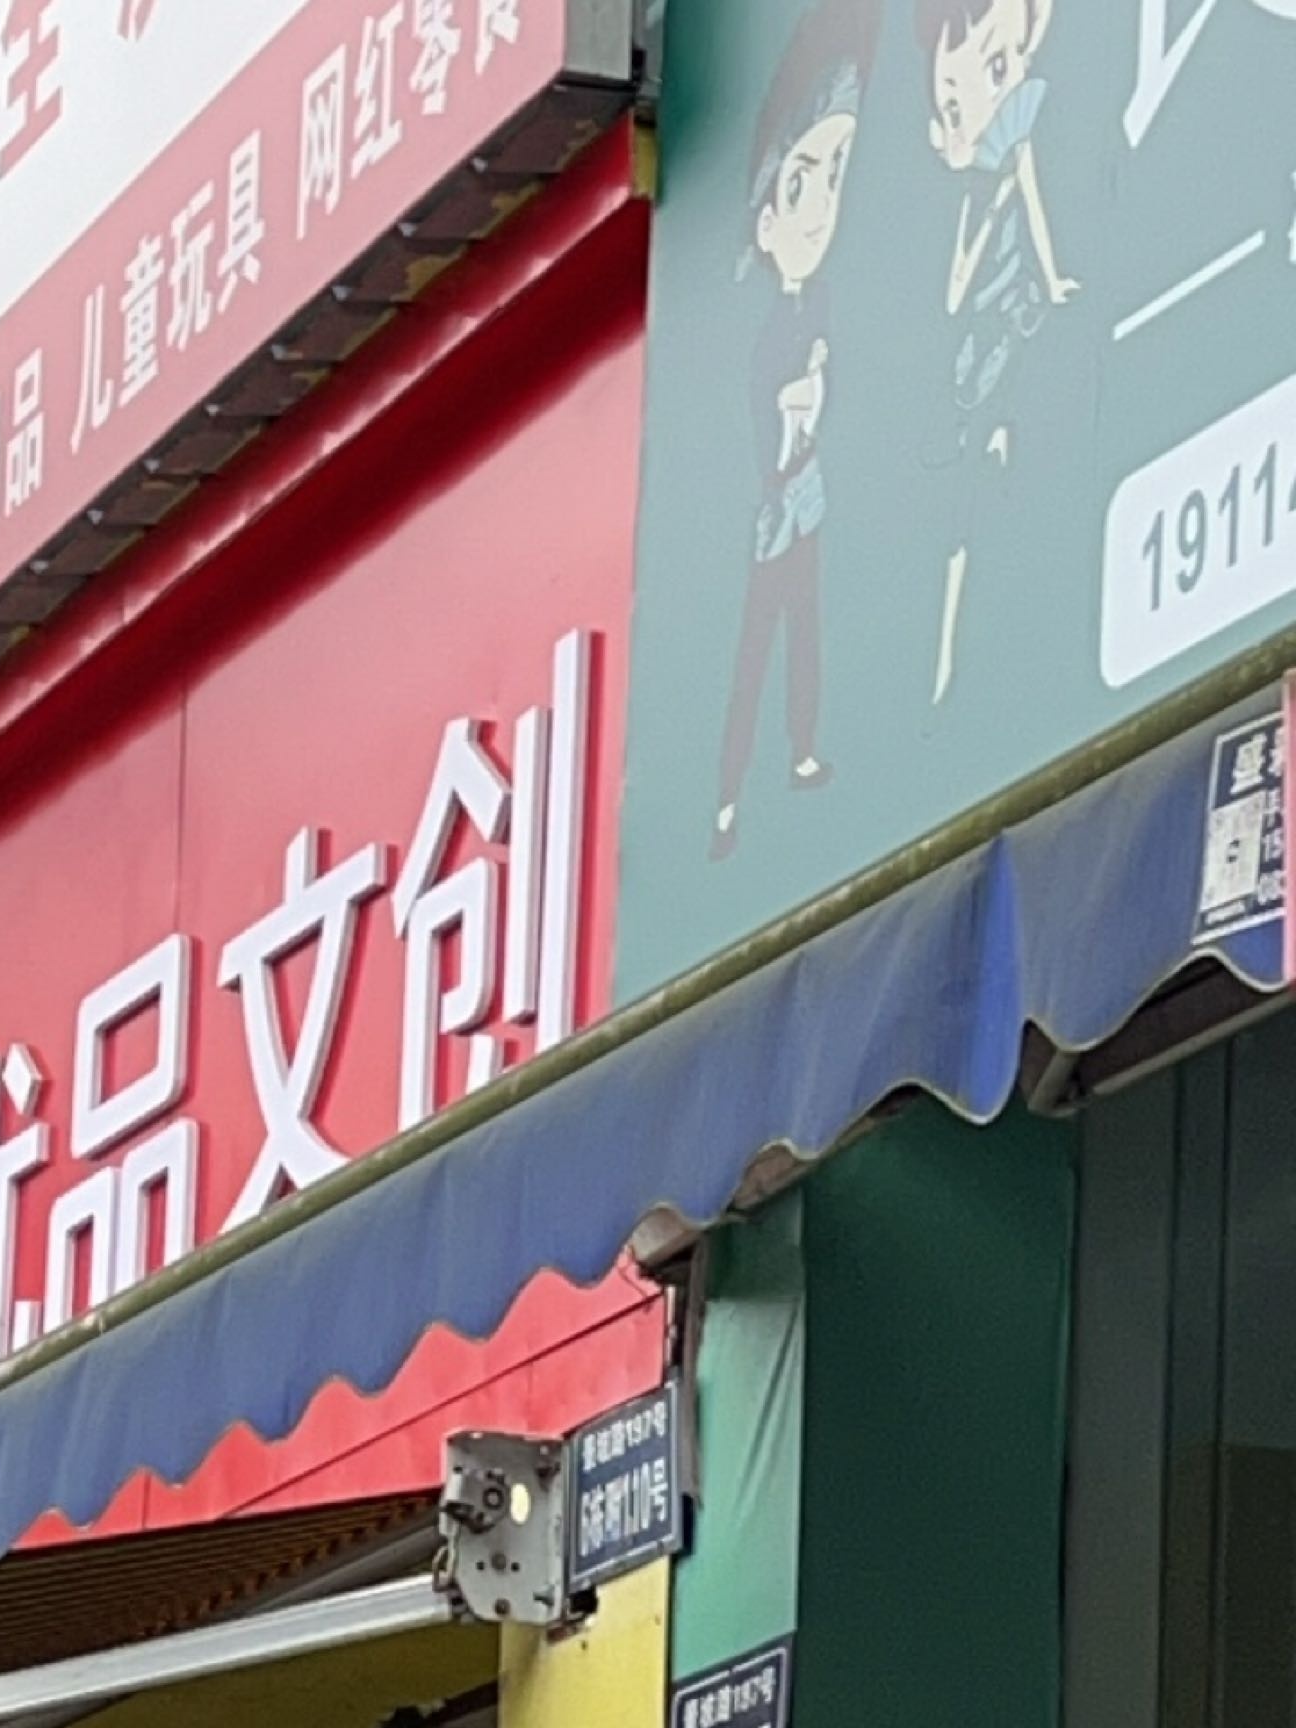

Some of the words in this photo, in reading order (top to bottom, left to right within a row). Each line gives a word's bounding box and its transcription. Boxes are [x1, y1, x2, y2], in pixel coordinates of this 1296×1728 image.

[70, 128, 266, 455] 儿童玩具
[1141, 441, 1296, 613] 1911
